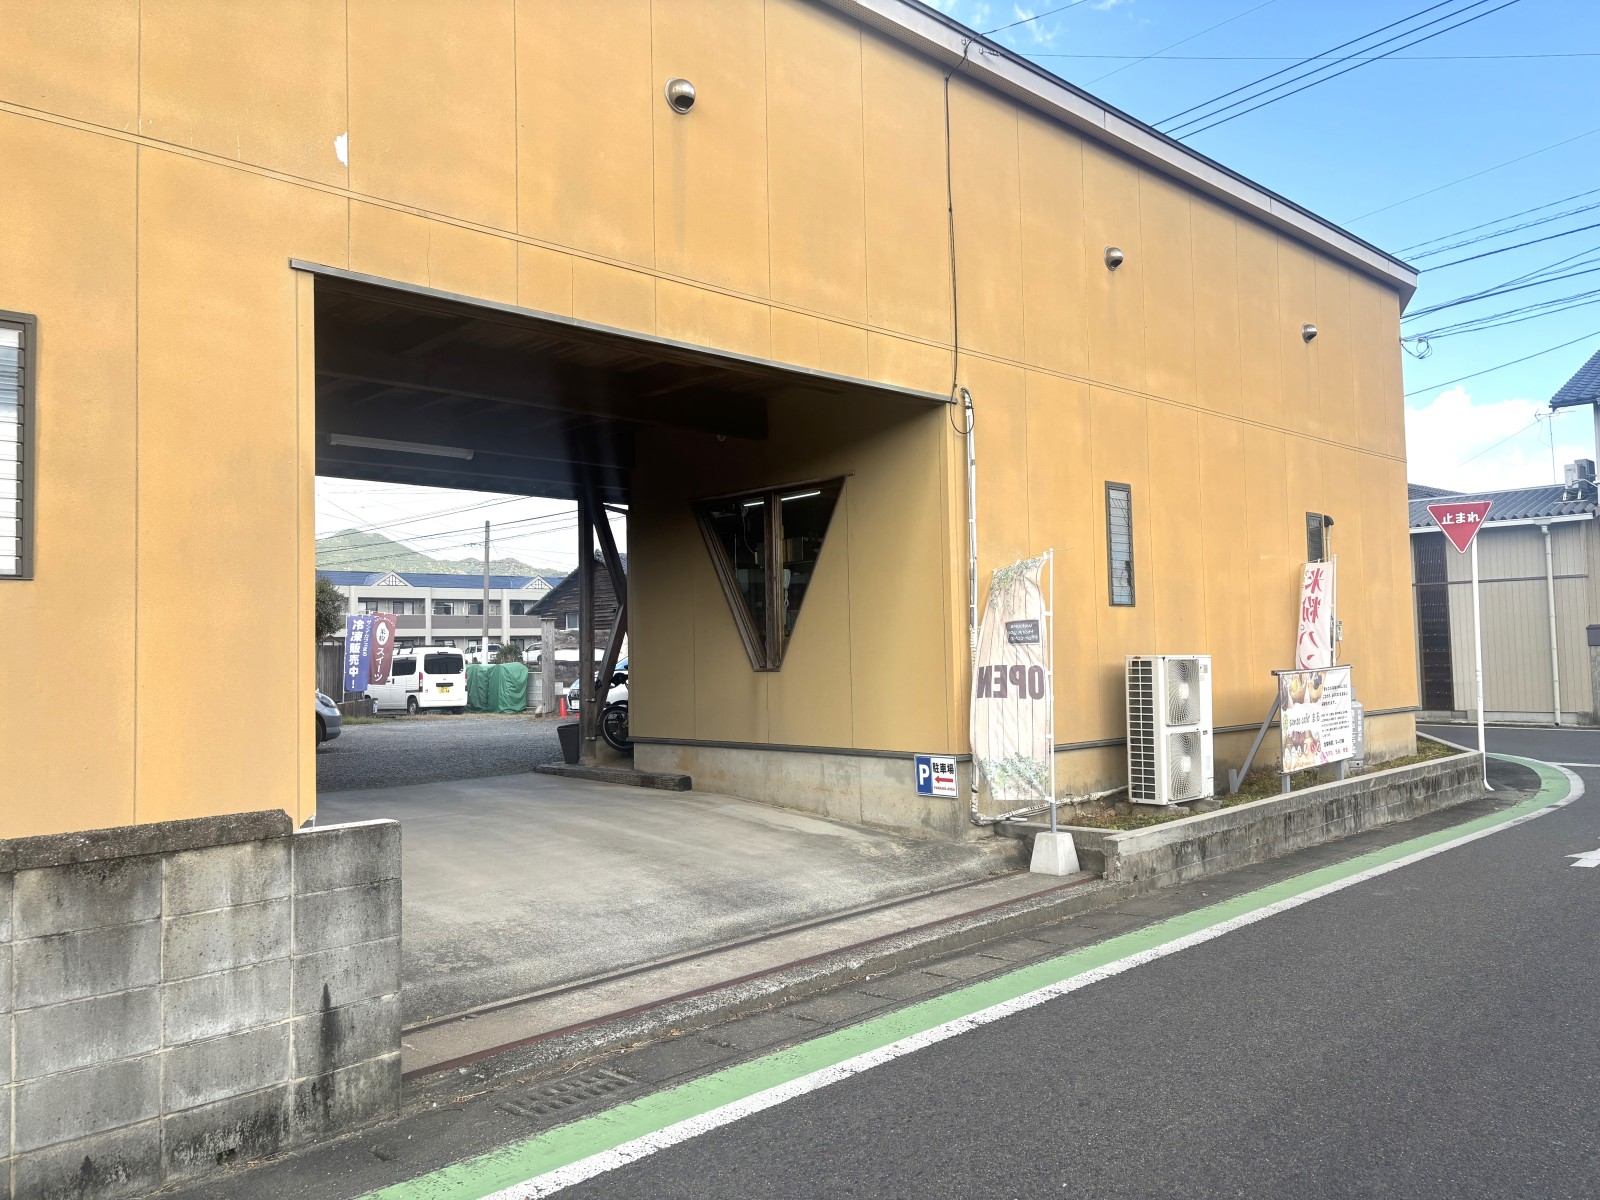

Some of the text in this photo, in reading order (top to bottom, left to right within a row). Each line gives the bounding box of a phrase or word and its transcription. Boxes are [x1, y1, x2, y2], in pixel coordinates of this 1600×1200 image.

[1441, 511, 1481, 525] 止まれ
[375, 648, 385, 681] スイーツ
[919, 764, 930, 785] P
[933, 763, 954, 775] 駐車場
